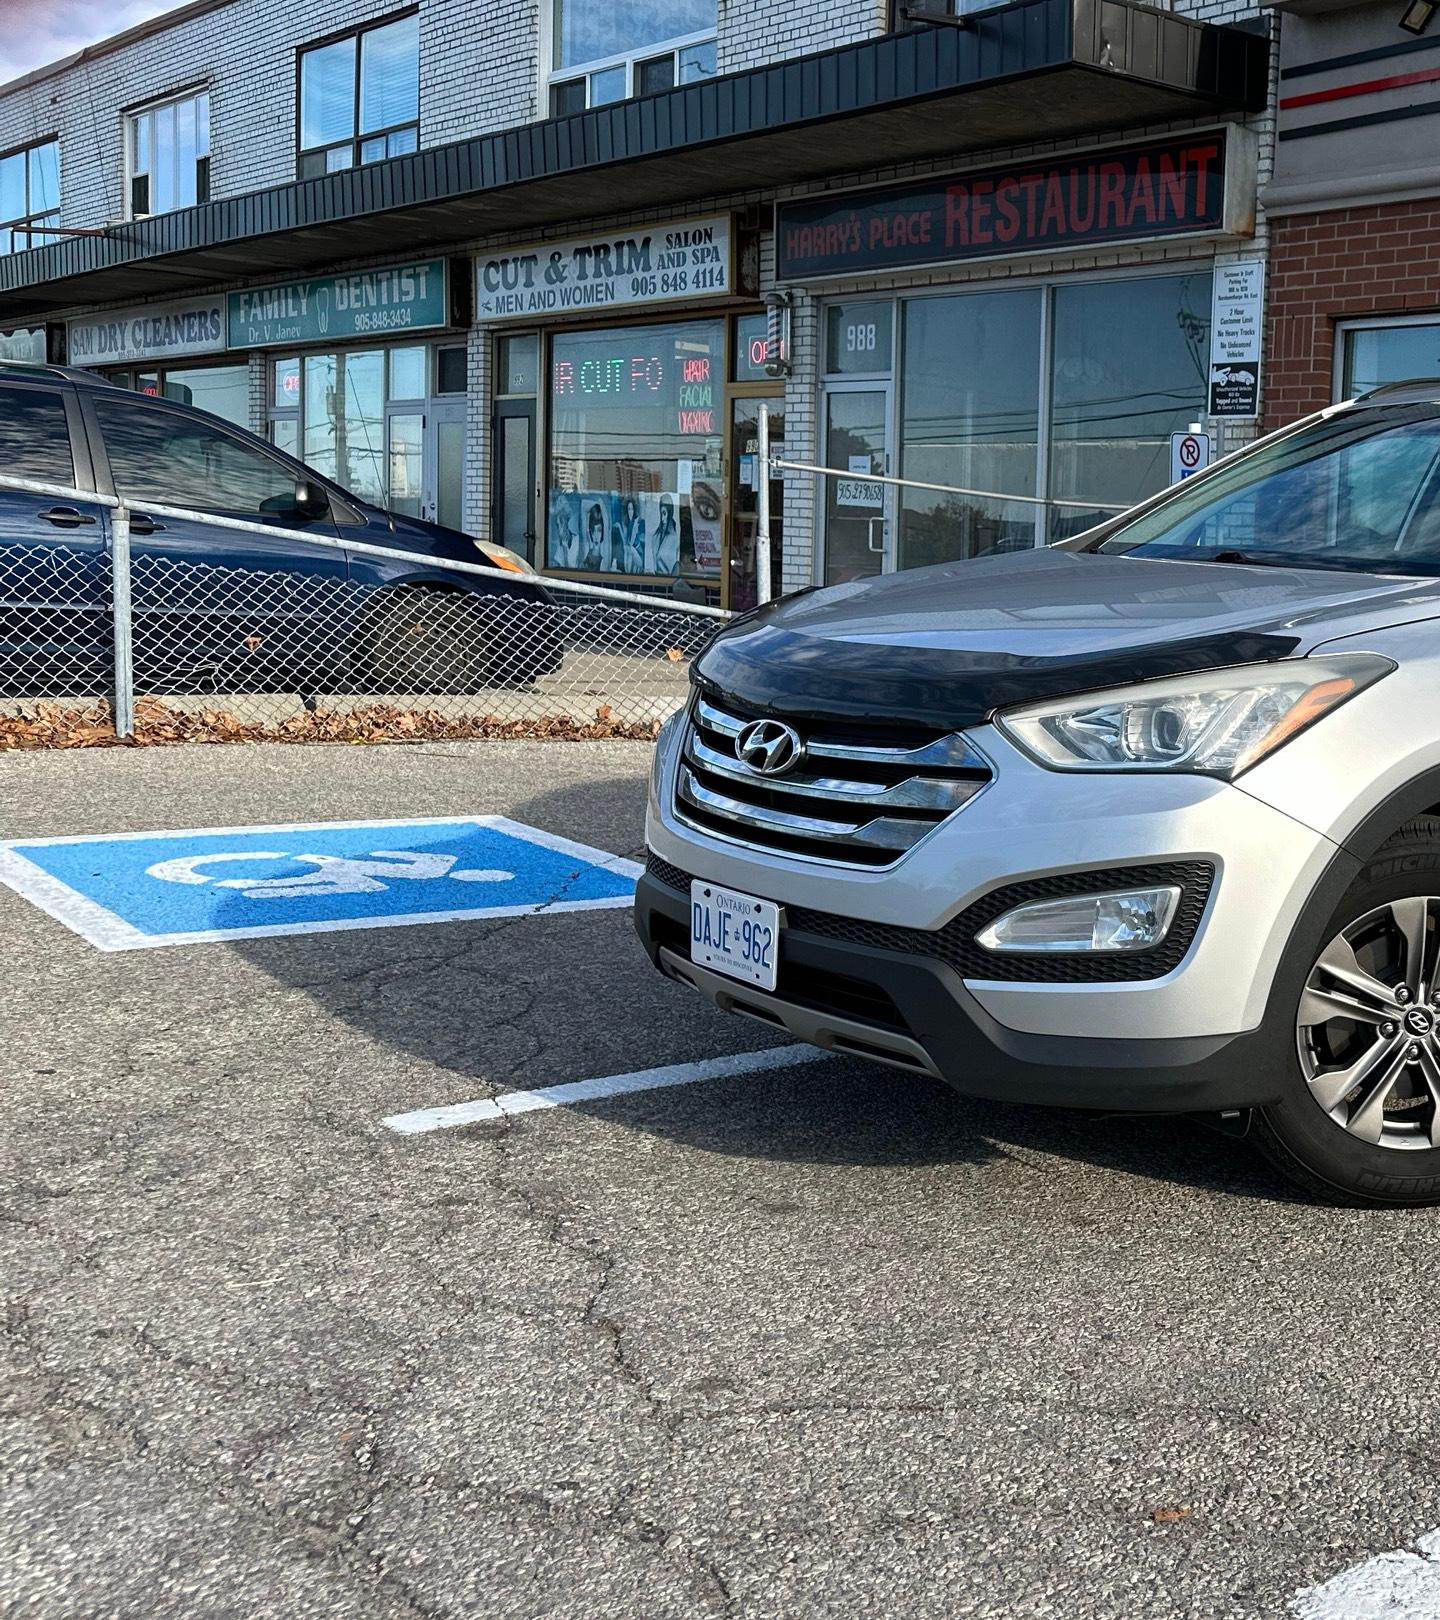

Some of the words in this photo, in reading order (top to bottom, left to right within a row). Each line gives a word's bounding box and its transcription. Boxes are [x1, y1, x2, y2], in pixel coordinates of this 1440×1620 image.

[786, 213, 861, 260] HARRY'S
[869, 211, 931, 250] PLACE
[944, 145, 1218, 247] RESTAURANT
[666, 227, 713, 251] SALON
[483, 253, 538, 293] CUT
[544, 250, 568, 284] &
[573, 236, 652, 281] TRIM
[657, 249, 687, 271] AND
[692, 245, 721, 266] SPA
[239, 284, 311, 324] FAMILY
[334, 265, 430, 311] DENTIST
[495, 293, 524, 314] MEN
[528, 288, 556, 311] AND
[559, 281, 615, 306] WOMEN
[631, 275, 656, 298] 905
[661, 271, 688, 292] 848
[691, 265, 725, 289] 4114
[72, 327, 94, 357] SAM
[98, 321, 128, 353] DRY
[131, 308, 221, 349] CLEANERS
[248, 327, 262, 343] Dr.
[263, 325, 274, 341] V.
[276, 324, 302, 340] Janev
[354, 308, 411, 331] 905-848-3434
[847, 323, 876, 351] 988
[580, 359, 624, 393] CUT
[716, 894, 751, 916] ONTARIO
[693, 902, 732, 954] DAJE
[742, 919, 772, 969] 962
